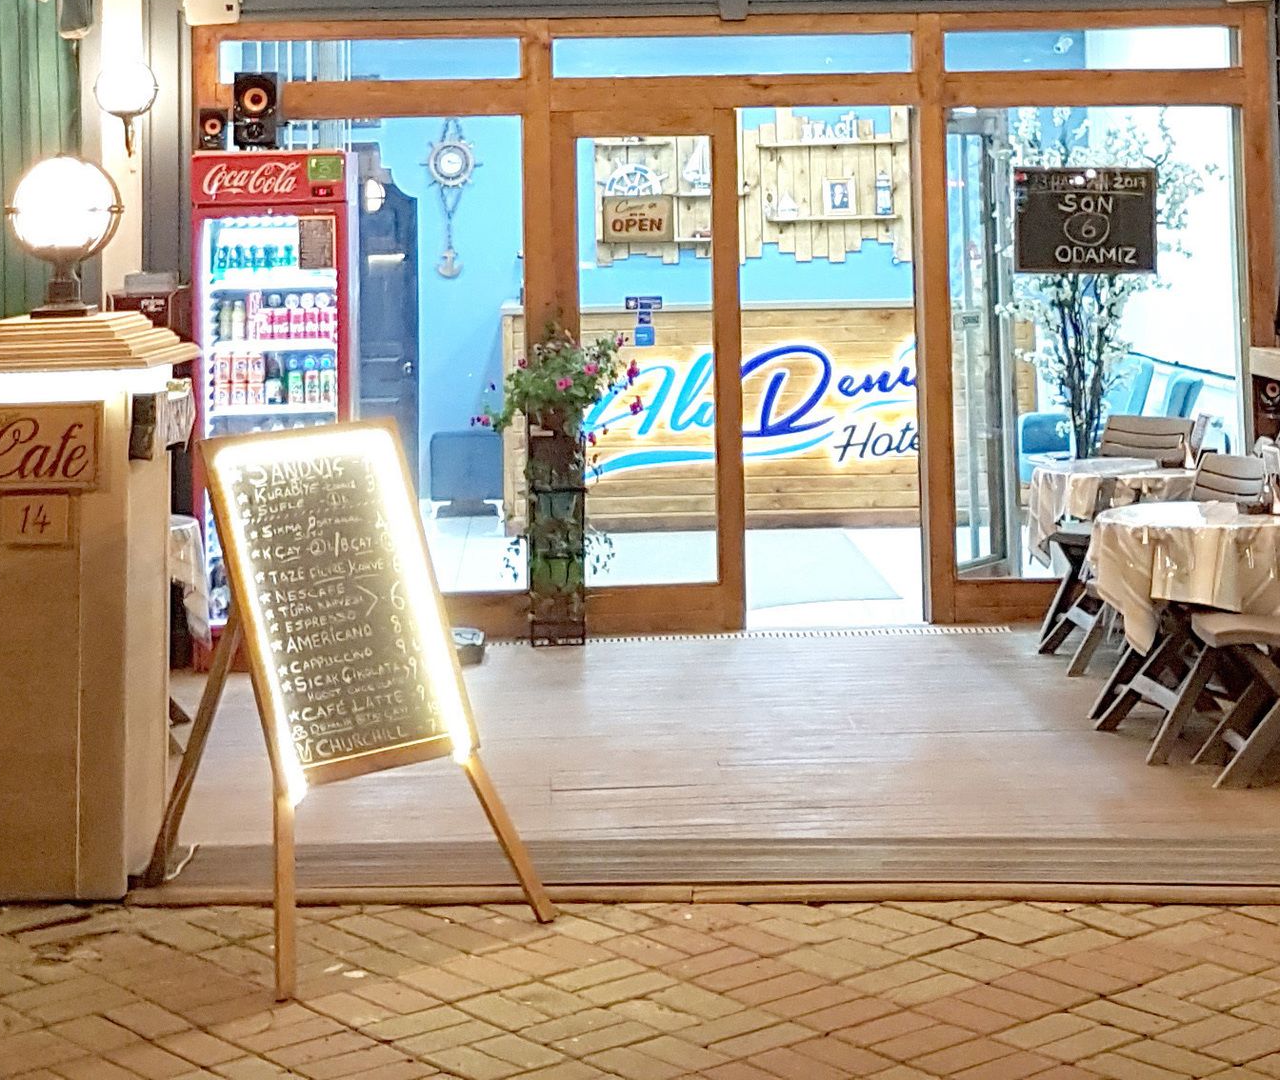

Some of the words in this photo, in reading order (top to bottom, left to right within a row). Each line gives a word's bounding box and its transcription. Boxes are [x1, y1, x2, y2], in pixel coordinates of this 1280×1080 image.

[202, 162, 302, 197] Coca-Cola
[1113, 176, 1147, 190] 2017
[1057, 193, 1114, 214] SON
[612, 218, 662, 232] OPEN
[1081, 219, 1096, 238] 6
[1055, 245, 1138, 264] ODAMIZ
[19, 503, 52, 535] 14
[268, 571, 306, 586] TAZE
[390, 580, 405, 611] 6
[352, 690, 406, 714] LATTE
